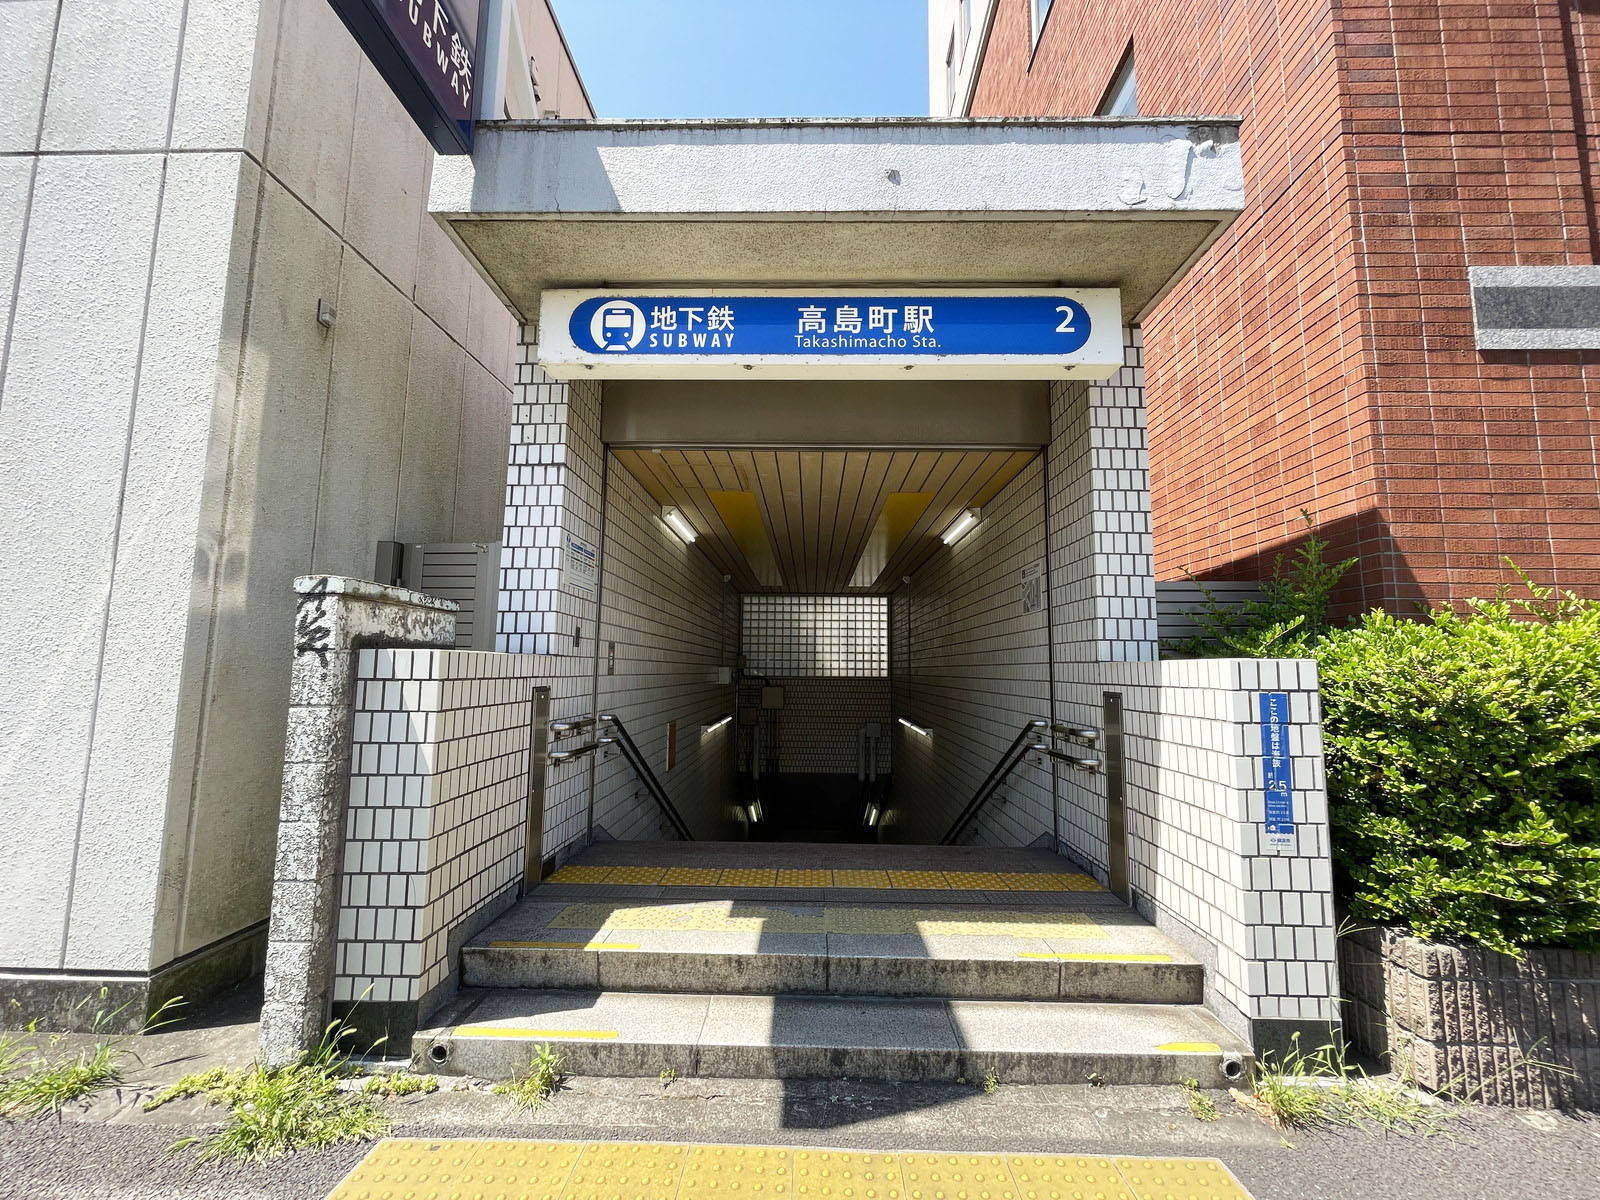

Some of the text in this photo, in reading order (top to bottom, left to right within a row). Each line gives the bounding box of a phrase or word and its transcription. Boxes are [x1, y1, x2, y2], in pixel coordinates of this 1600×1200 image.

[400, 0, 470, 108] UBWAY
[417, 0, 472, 90] 下鉄
[650, 305, 735, 331] 地下鉄
[797, 304, 935, 334] 高島町駅
[1055, 305, 1075, 333] 2
[649, 333, 735, 348] SUBWAY
[794, 335, 942, 348] Takashimacho Sta.
